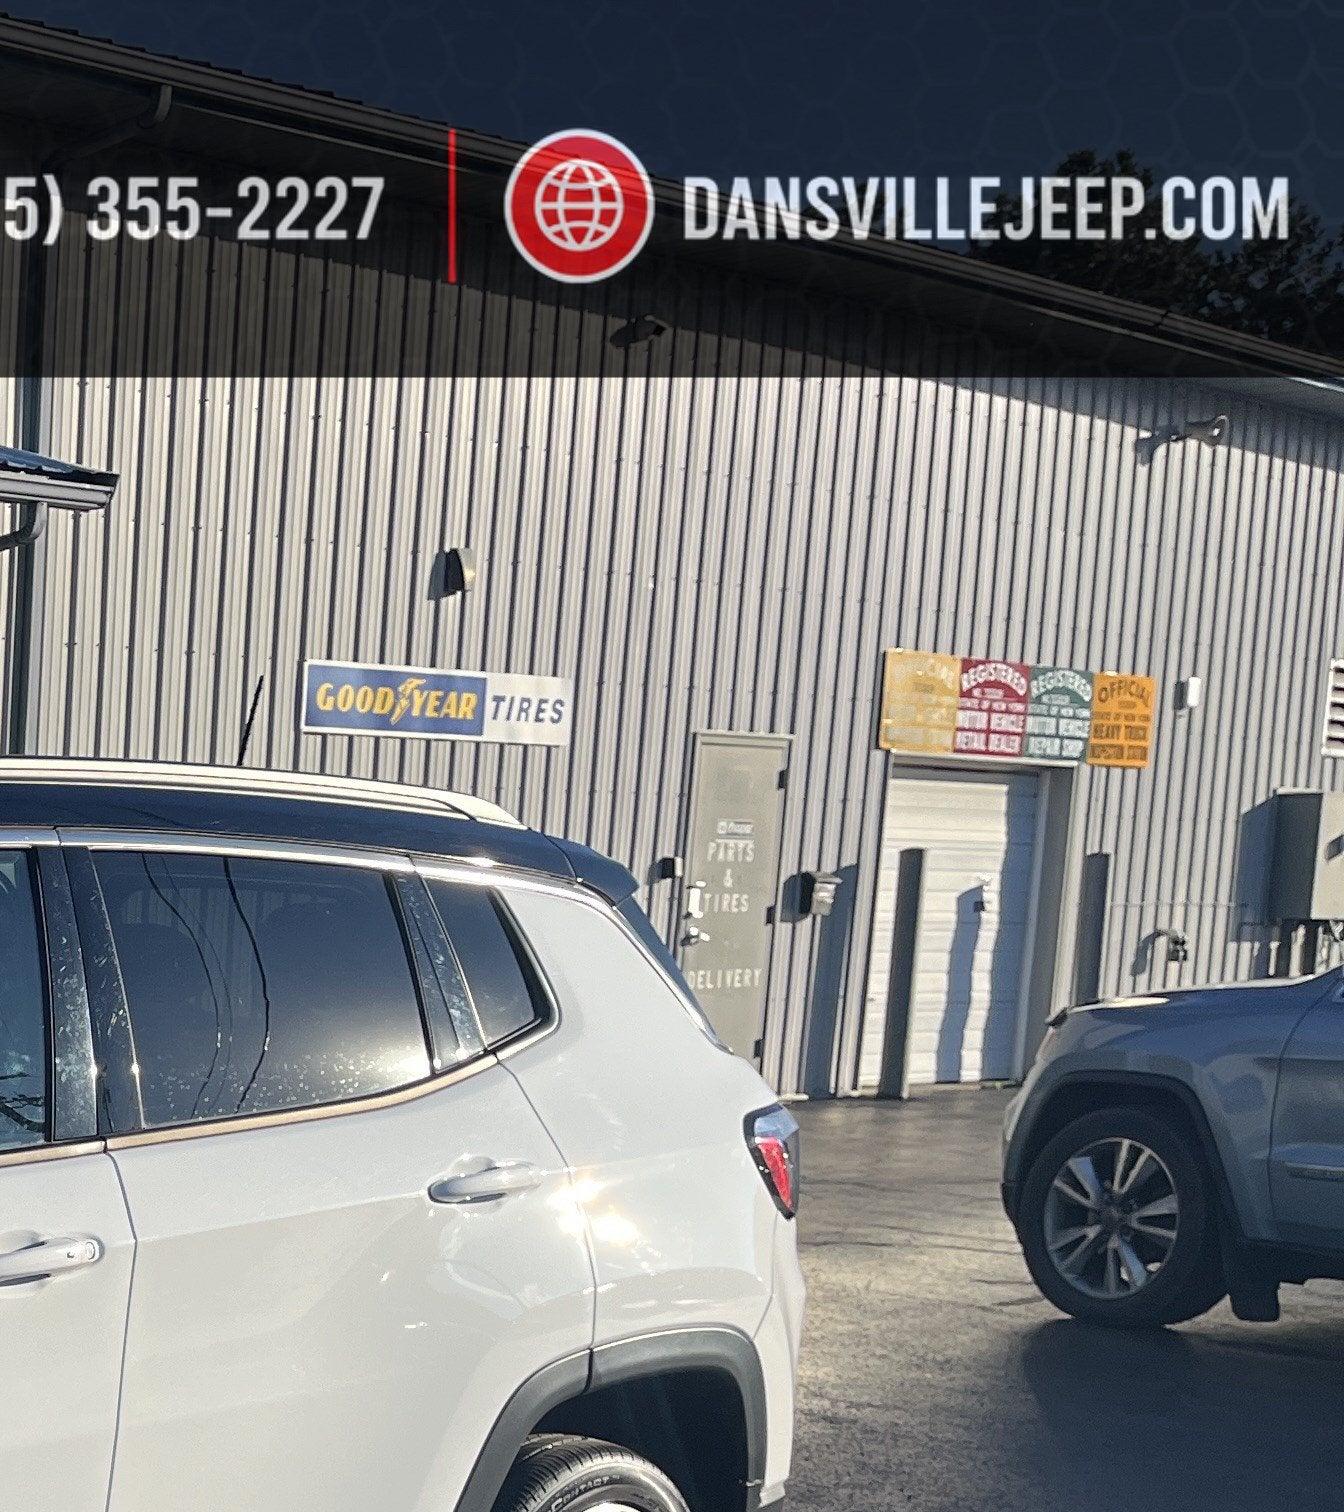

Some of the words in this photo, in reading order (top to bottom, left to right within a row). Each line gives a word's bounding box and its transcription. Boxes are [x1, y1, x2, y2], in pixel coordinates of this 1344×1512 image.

[315, 679, 478, 722] GOODYEAR
[491, 695, 565, 724] TIRES
[1098, 680, 1151, 707] OFFICIAL
[707, 841, 754, 863] PARTS
[723, 868, 733, 888] &
[704, 894, 749, 913] TIRES
[687, 968, 762, 989] DELIVERY
